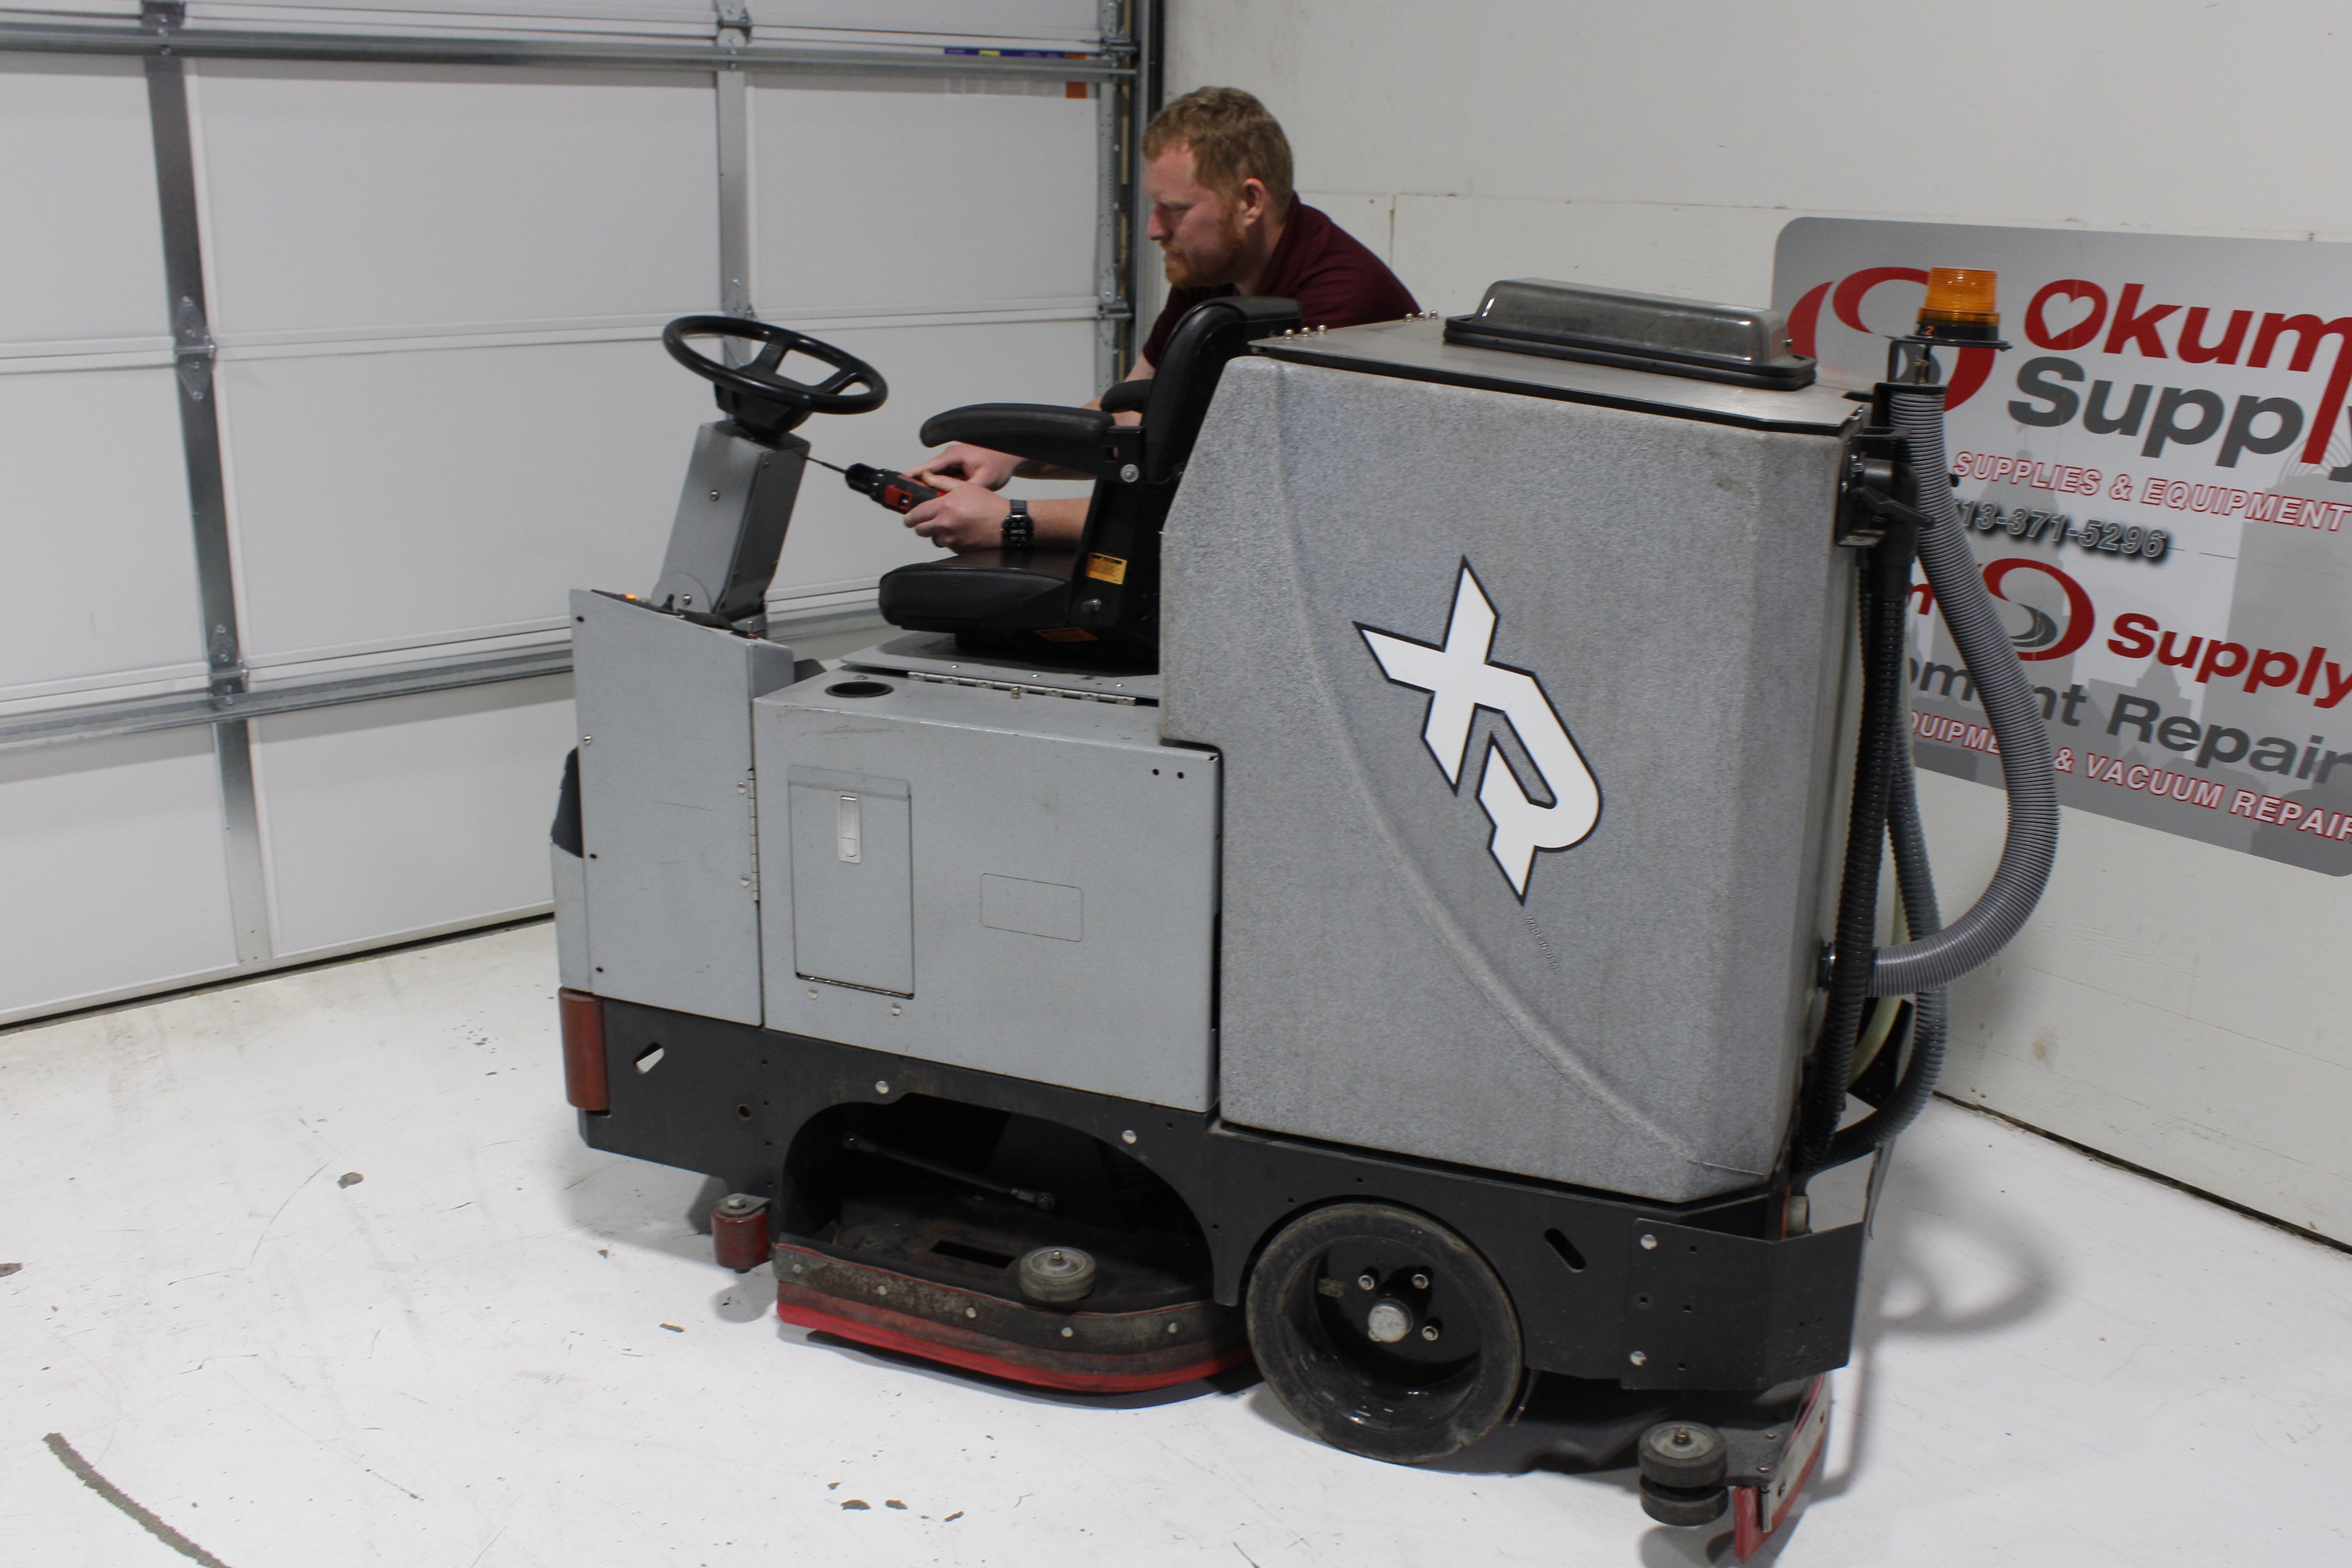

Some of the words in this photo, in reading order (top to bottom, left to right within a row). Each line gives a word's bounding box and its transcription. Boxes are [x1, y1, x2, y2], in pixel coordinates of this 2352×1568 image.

[2024, 279, 2352, 374] Okum
[2007, 356, 2352, 483] Suppl
[1952, 451, 2103, 496] SUPPLIES
[2108, 473, 2133, 501] &
[2139, 477, 2352, 532] EQUIPMENT
[1954, 498, 2167, 558] 13-371-5296
[2053, 747, 2075, 773] &
[2086, 753, 2226, 810] VACUUM
[2106, 692, 2352, 784] Repair
